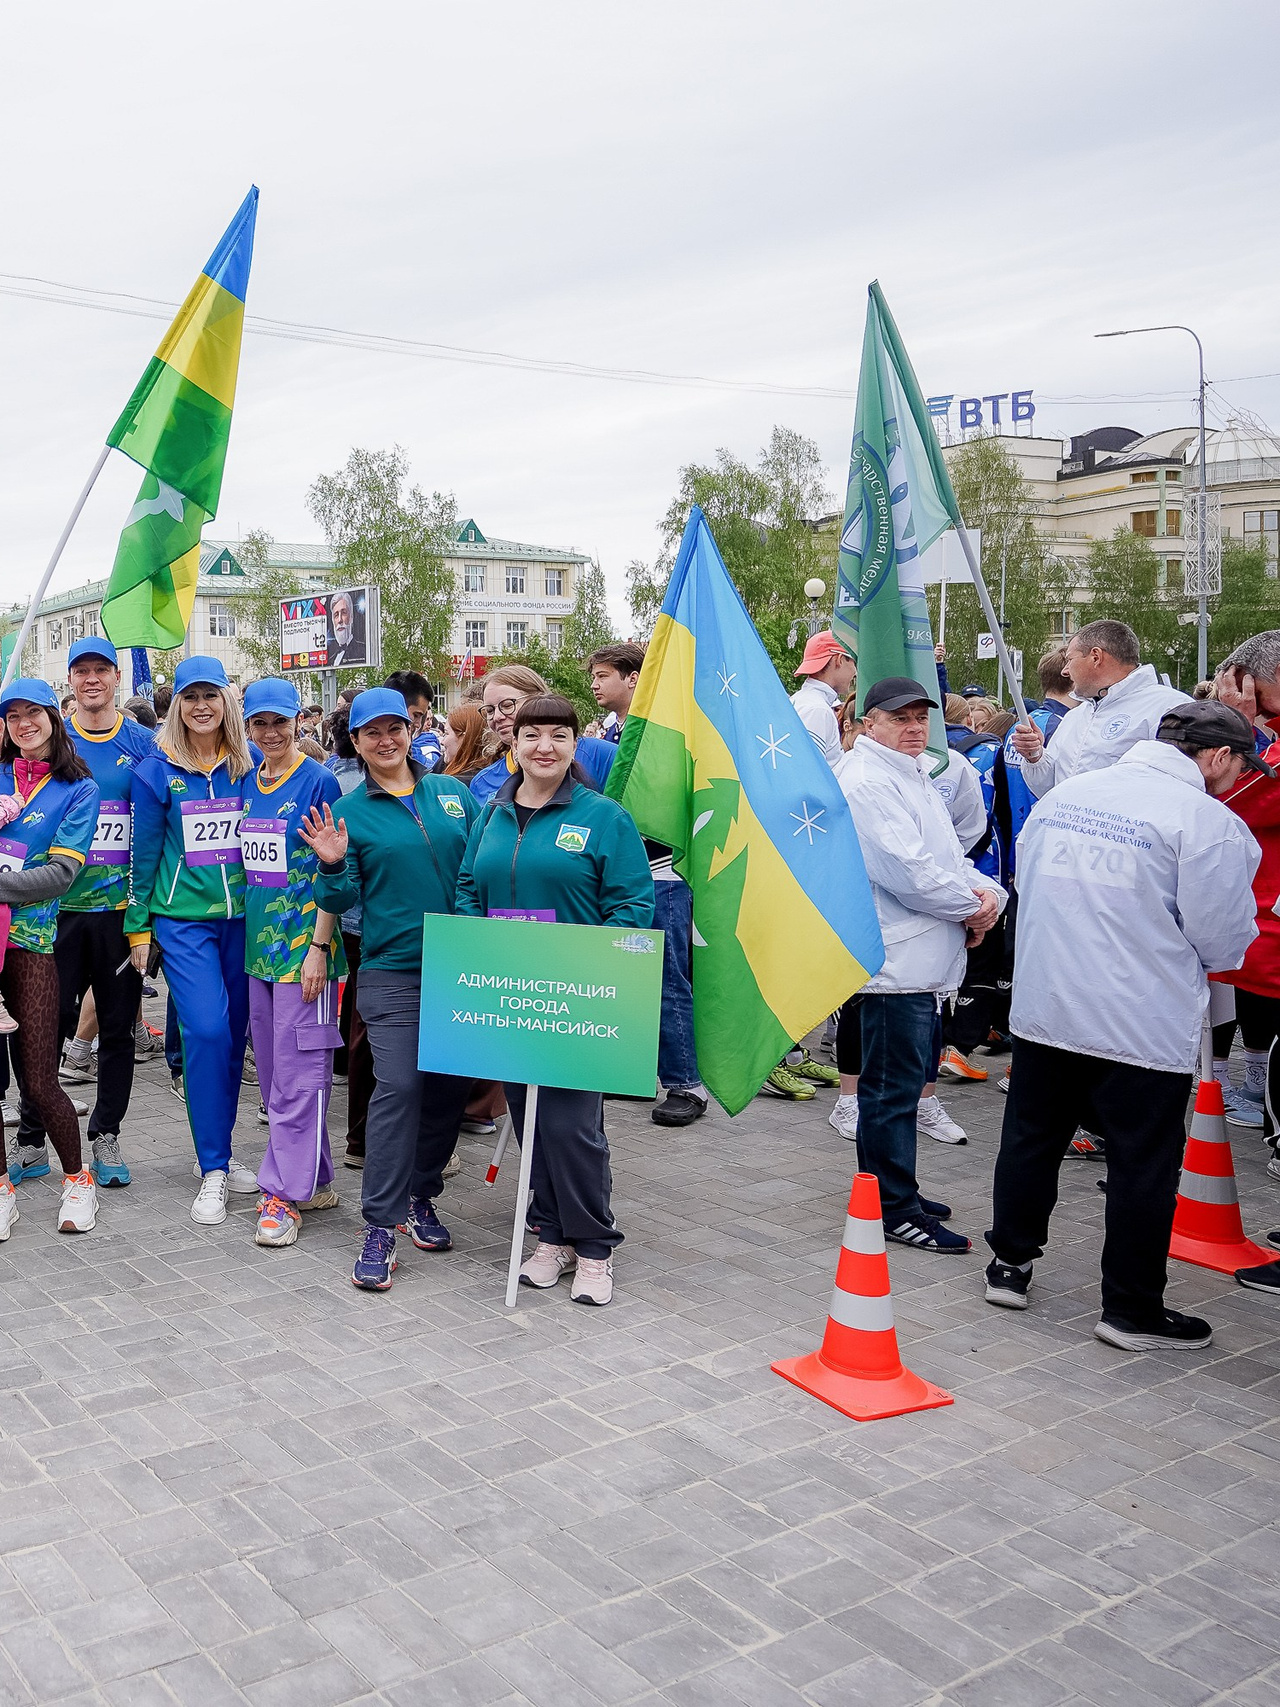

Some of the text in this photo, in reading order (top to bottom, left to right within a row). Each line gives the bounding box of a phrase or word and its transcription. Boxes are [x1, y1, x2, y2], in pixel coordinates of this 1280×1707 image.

[960, 390, 1036, 429] ВТБ
[473, 600, 521, 608] СОЦИАЛЬНОГО
[1053, 811, 1136, 836] ГОСУДАРСТВЕННАЯ
[1055, 801, 1146, 828] ХАНТЫ-МАНСИЙСКАЯ
[1038, 817, 1152, 850] МЕДИЦИНСКАЯ АКАДЕМИЯ
[243, 841, 278, 862] 2065
[456, 972, 617, 999] АДМИНИСТРАЦИЯ
[500, 995, 571, 1015] ГОРОДА
[451, 1010, 619, 1039] ХАНТЫ-МАНСИЙСК
